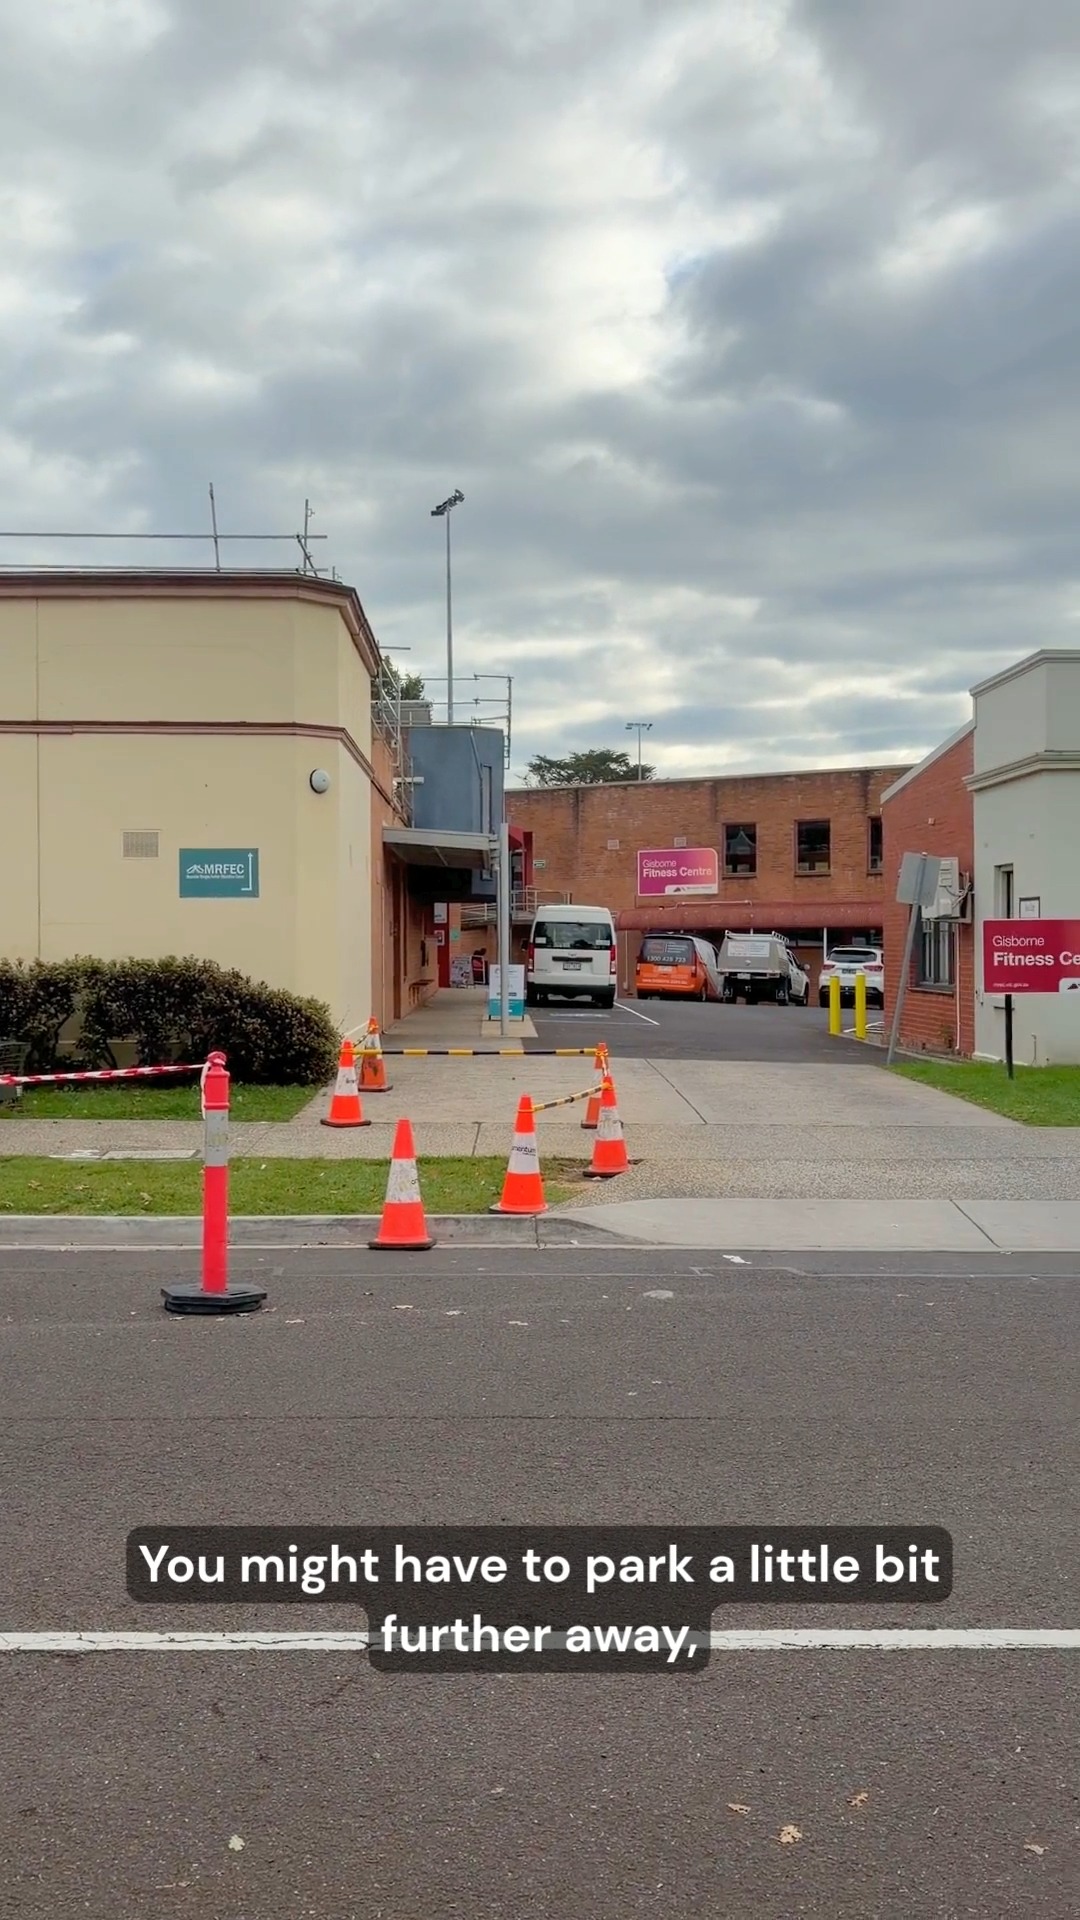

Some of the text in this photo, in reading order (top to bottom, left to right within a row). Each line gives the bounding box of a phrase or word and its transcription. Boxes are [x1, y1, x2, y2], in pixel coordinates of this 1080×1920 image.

[204, 863, 245, 874] MRFEC
[642, 859, 677, 868] Gisborne
[643, 867, 712, 877] Fitness Centre
[992, 935, 1045, 947] Gisborne
[993, 952, 1054, 966] Fitness
